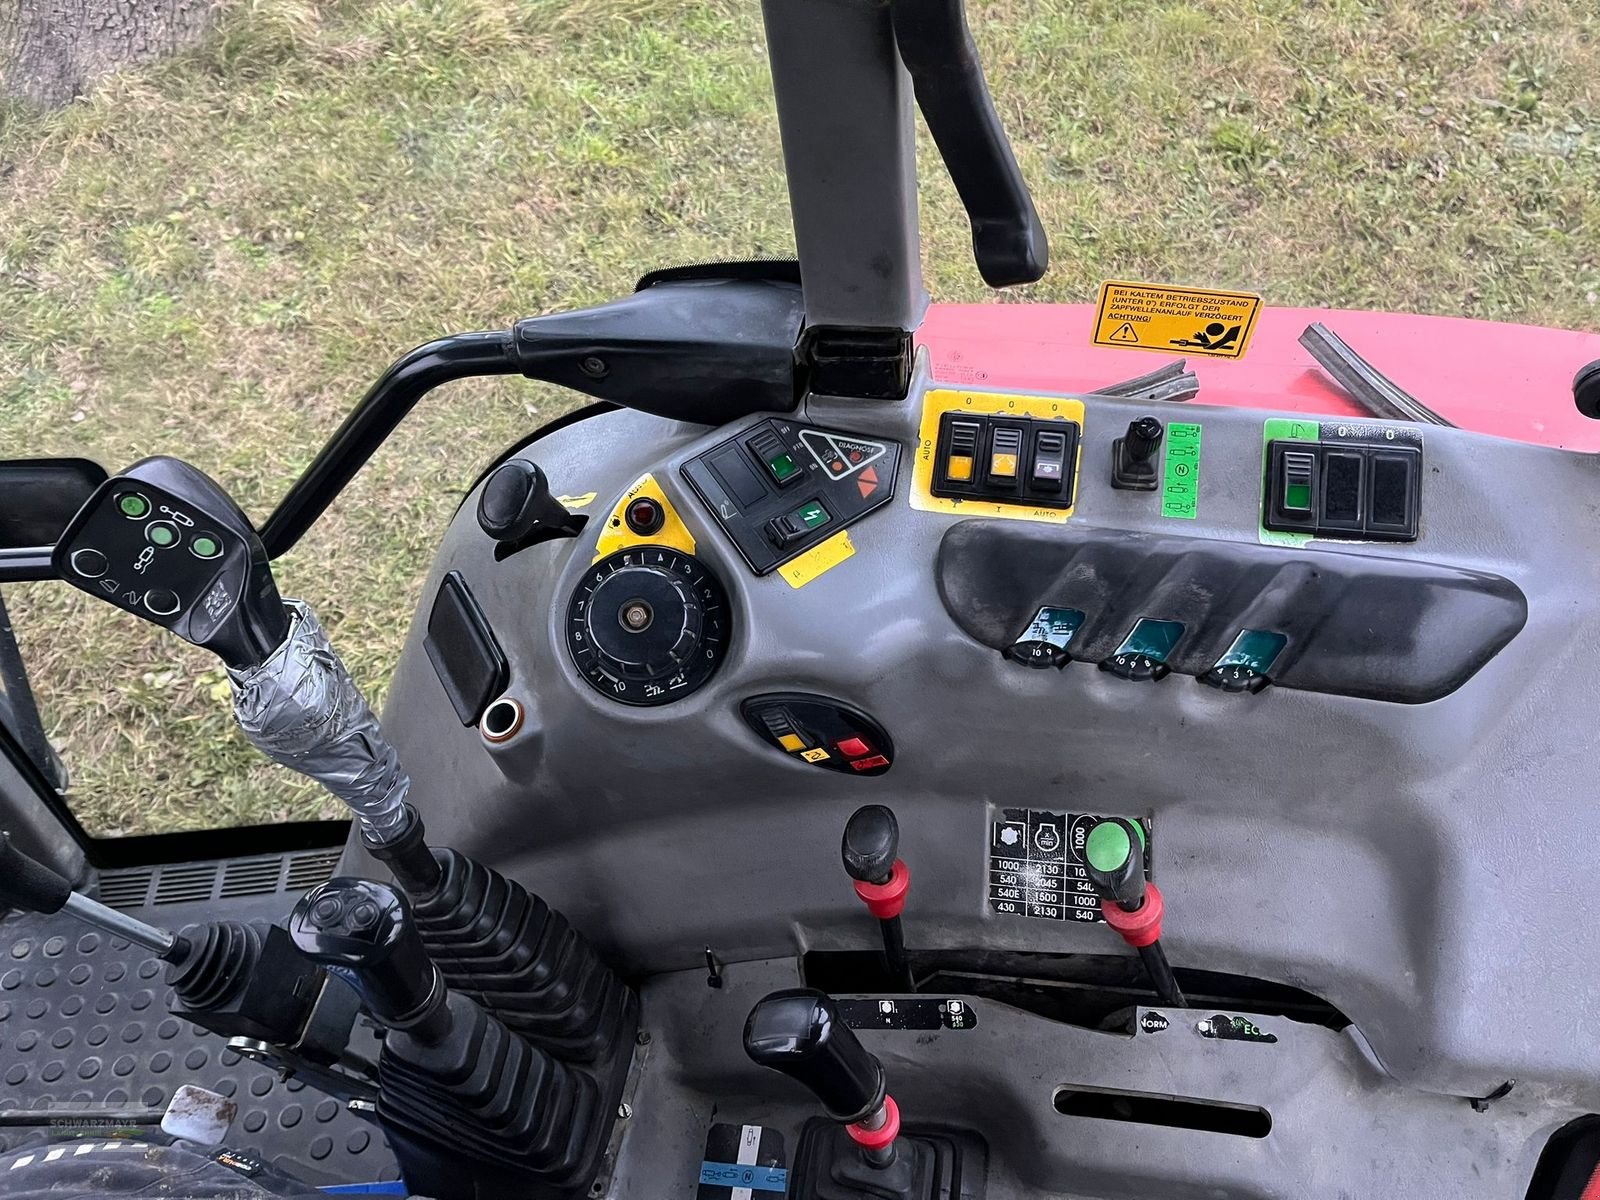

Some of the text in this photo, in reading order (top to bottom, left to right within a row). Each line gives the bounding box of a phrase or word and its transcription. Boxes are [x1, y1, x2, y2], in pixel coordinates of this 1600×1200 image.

[1112, 297, 1144, 305] (UNTER
[1160, 301, 1200, 310] ERFOLGT
[1130, 291, 1164, 299] KALTEM
[1166, 294, 1249, 307] BETRIEBSZUSTAND
[1110, 303, 1191, 317] ZAPFWELLENANLAUF
[1107, 312, 1152, 322] ACHTUNG!
[922, 439, 932, 461] AUTO
[1033, 510, 1057, 519] AUTO
[684, 564, 692, 574] 3
[595, 572, 603, 582] 6
[704, 588, 712, 598] 2
[577, 601, 585, 611] 7
[574, 631, 582, 642] 8
[1032, 648, 1042, 657] 10
[1115, 655, 1126, 665] 10
[613, 681, 626, 693] 10
[1075, 827, 1085, 849] 1000
[998, 860, 1020, 871] 1000
[1036, 864, 1058, 875] 2130
[1000, 874, 1017, 885] 540
[998, 888, 1096, 907] 540E 1500 1000
[997, 902, 1094, 921] 430 2130 540
[1140, 1018, 1168, 1029] NORM
